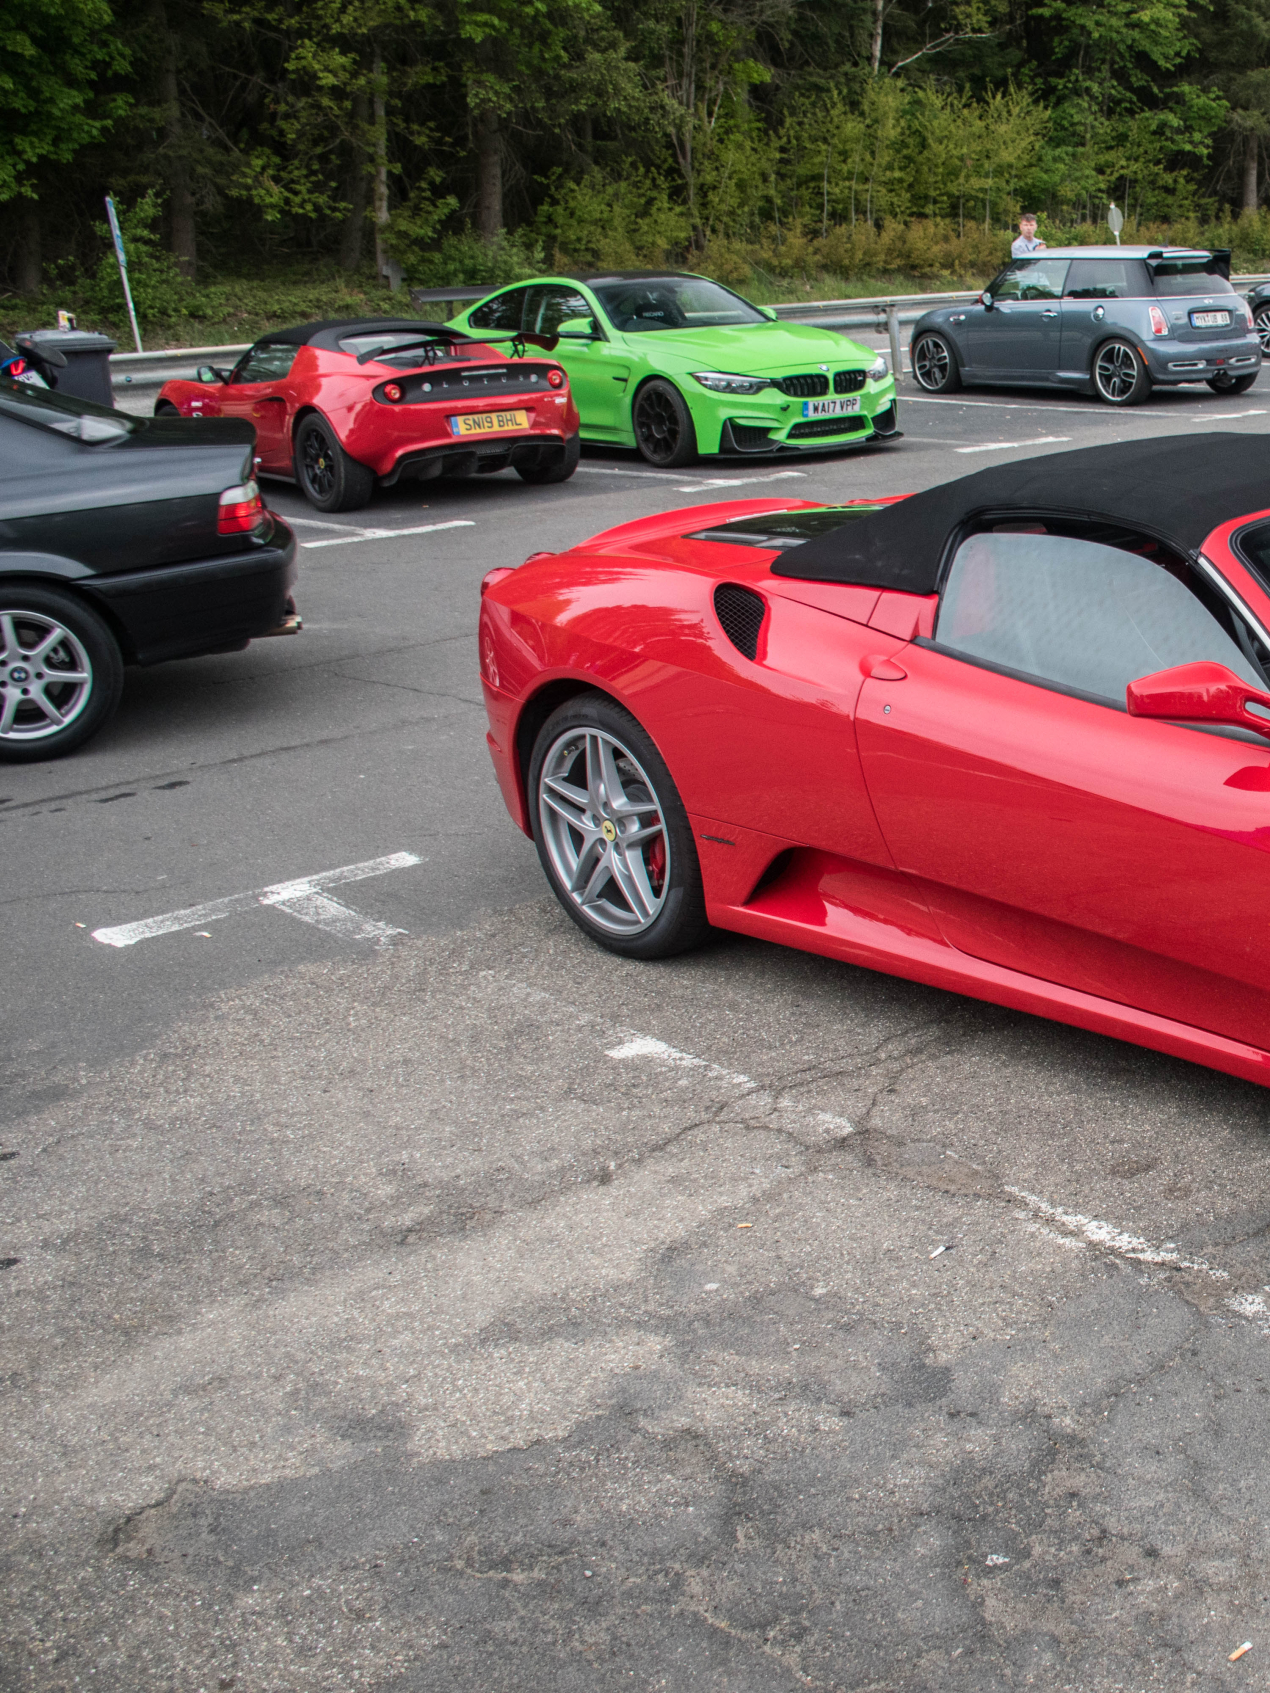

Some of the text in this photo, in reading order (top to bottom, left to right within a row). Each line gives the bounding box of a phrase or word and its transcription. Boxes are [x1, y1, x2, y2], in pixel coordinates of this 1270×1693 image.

[443, 375, 524, 388] LOTUS
[813, 398, 858, 414] WA17 VPP
[463, 412, 522, 431] SN19 BHL
